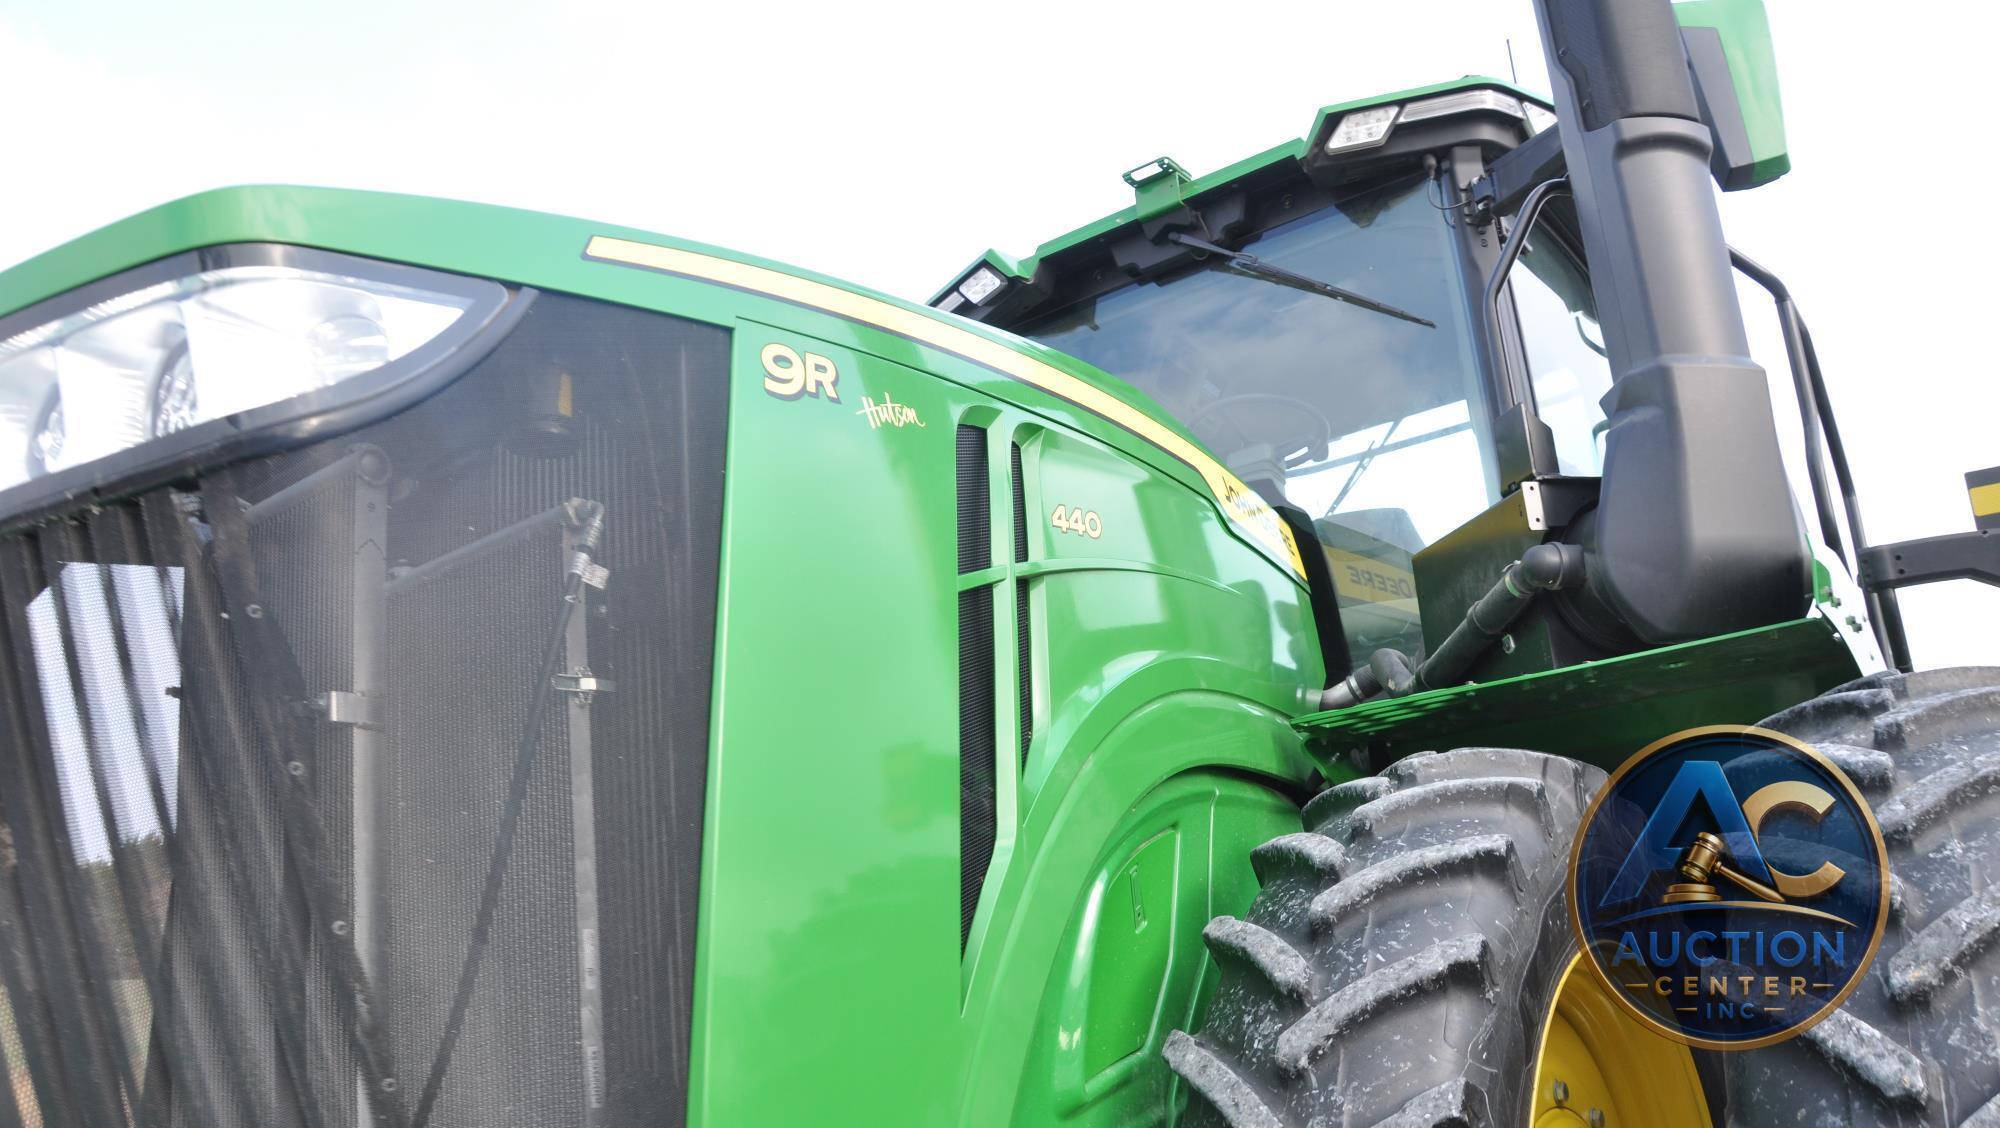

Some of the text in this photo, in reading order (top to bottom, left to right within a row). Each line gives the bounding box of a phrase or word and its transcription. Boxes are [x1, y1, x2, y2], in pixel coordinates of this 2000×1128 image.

[760, 343, 842, 404] 9R
[856, 392, 926, 429] Hutson
[1051, 504, 1103, 539] 440
